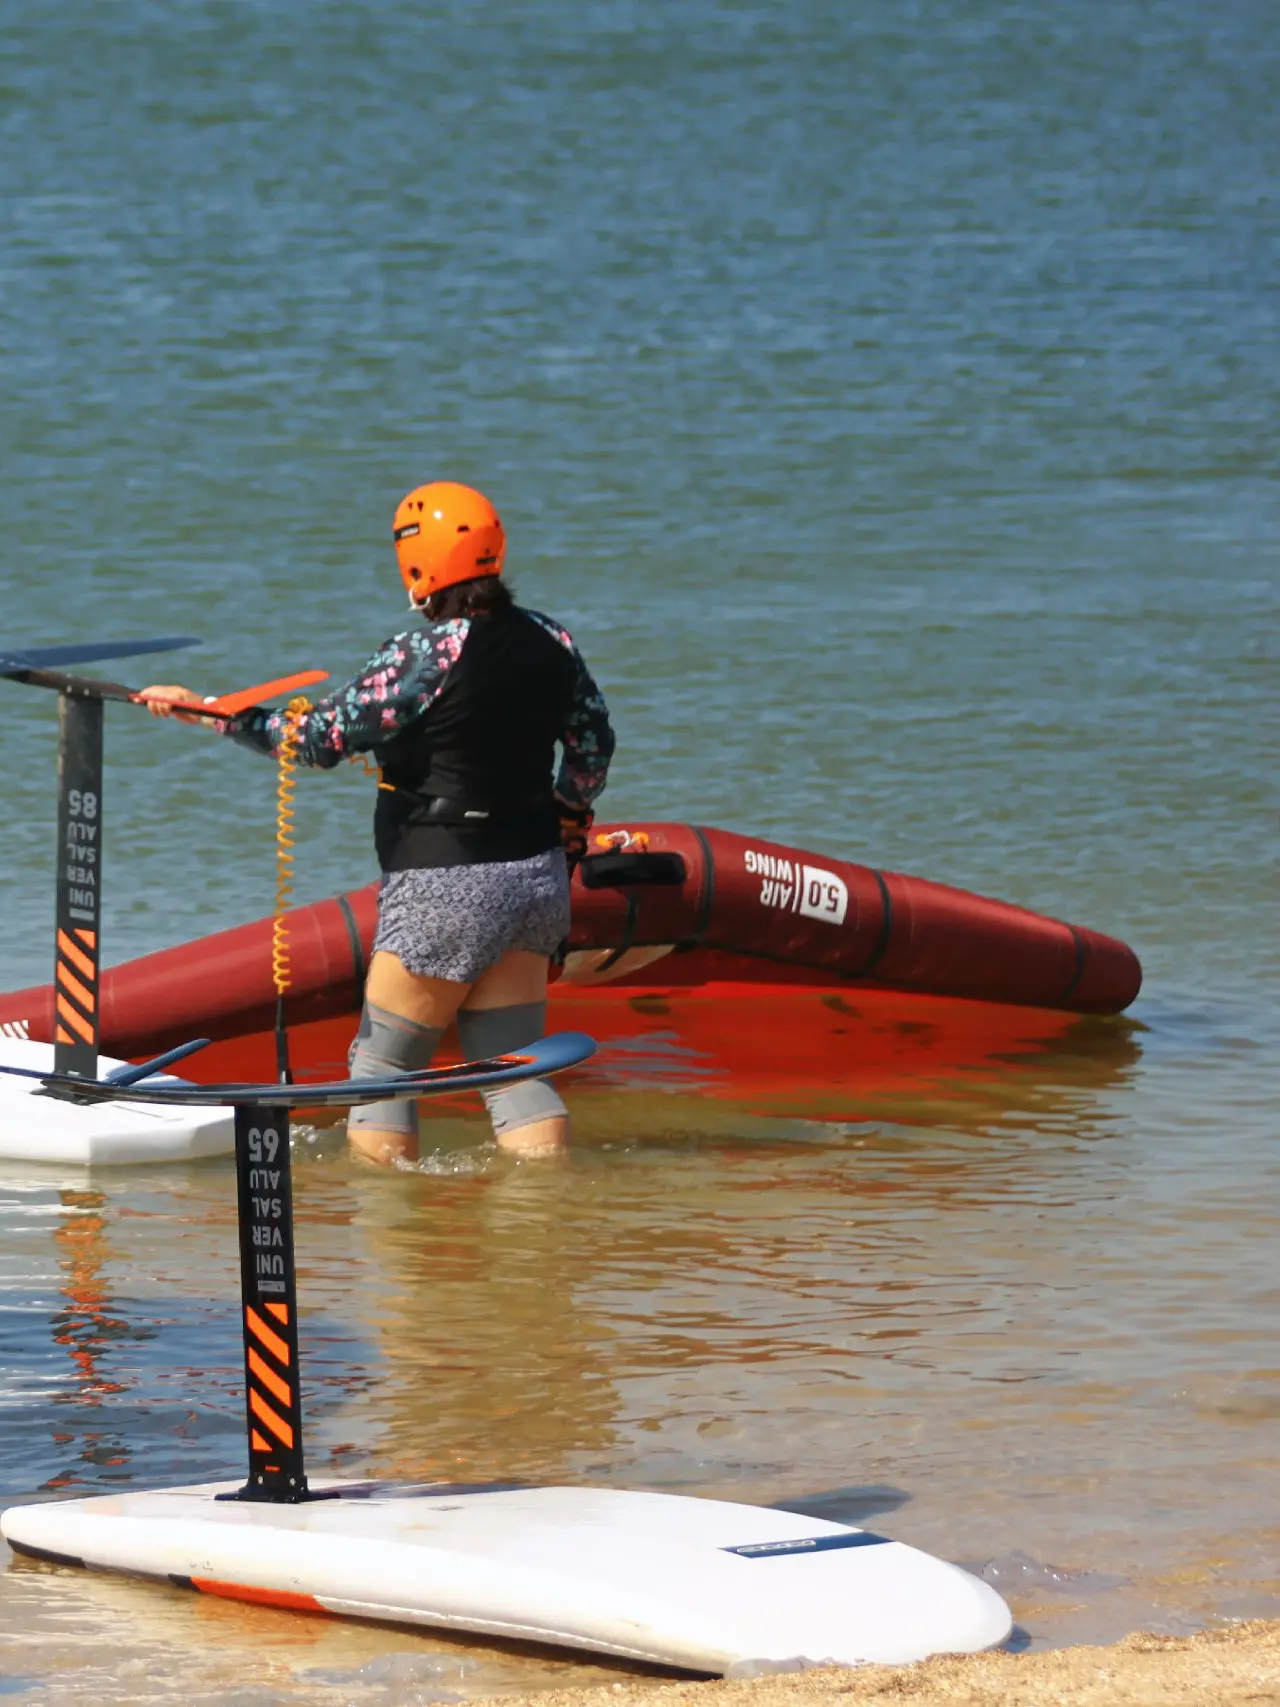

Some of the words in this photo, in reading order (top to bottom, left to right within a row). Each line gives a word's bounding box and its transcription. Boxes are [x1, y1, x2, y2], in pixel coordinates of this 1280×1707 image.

[68, 789, 97, 819] 85
[67, 821, 97, 841] ALU
[66, 842, 96, 864] SAL
[66, 864, 95, 886] VER
[744, 850, 793, 882] WING
[69, 887, 94, 907] UNI
[760, 879, 792, 909] AIR
[808, 880, 839, 912] 5.0
[248, 1128, 279, 1162] 65
[249, 1169, 280, 1190] ALU
[251, 1198, 282, 1218] SAL
[252, 1225, 283, 1246] VER
[256, 1254, 284, 1274] UNI
